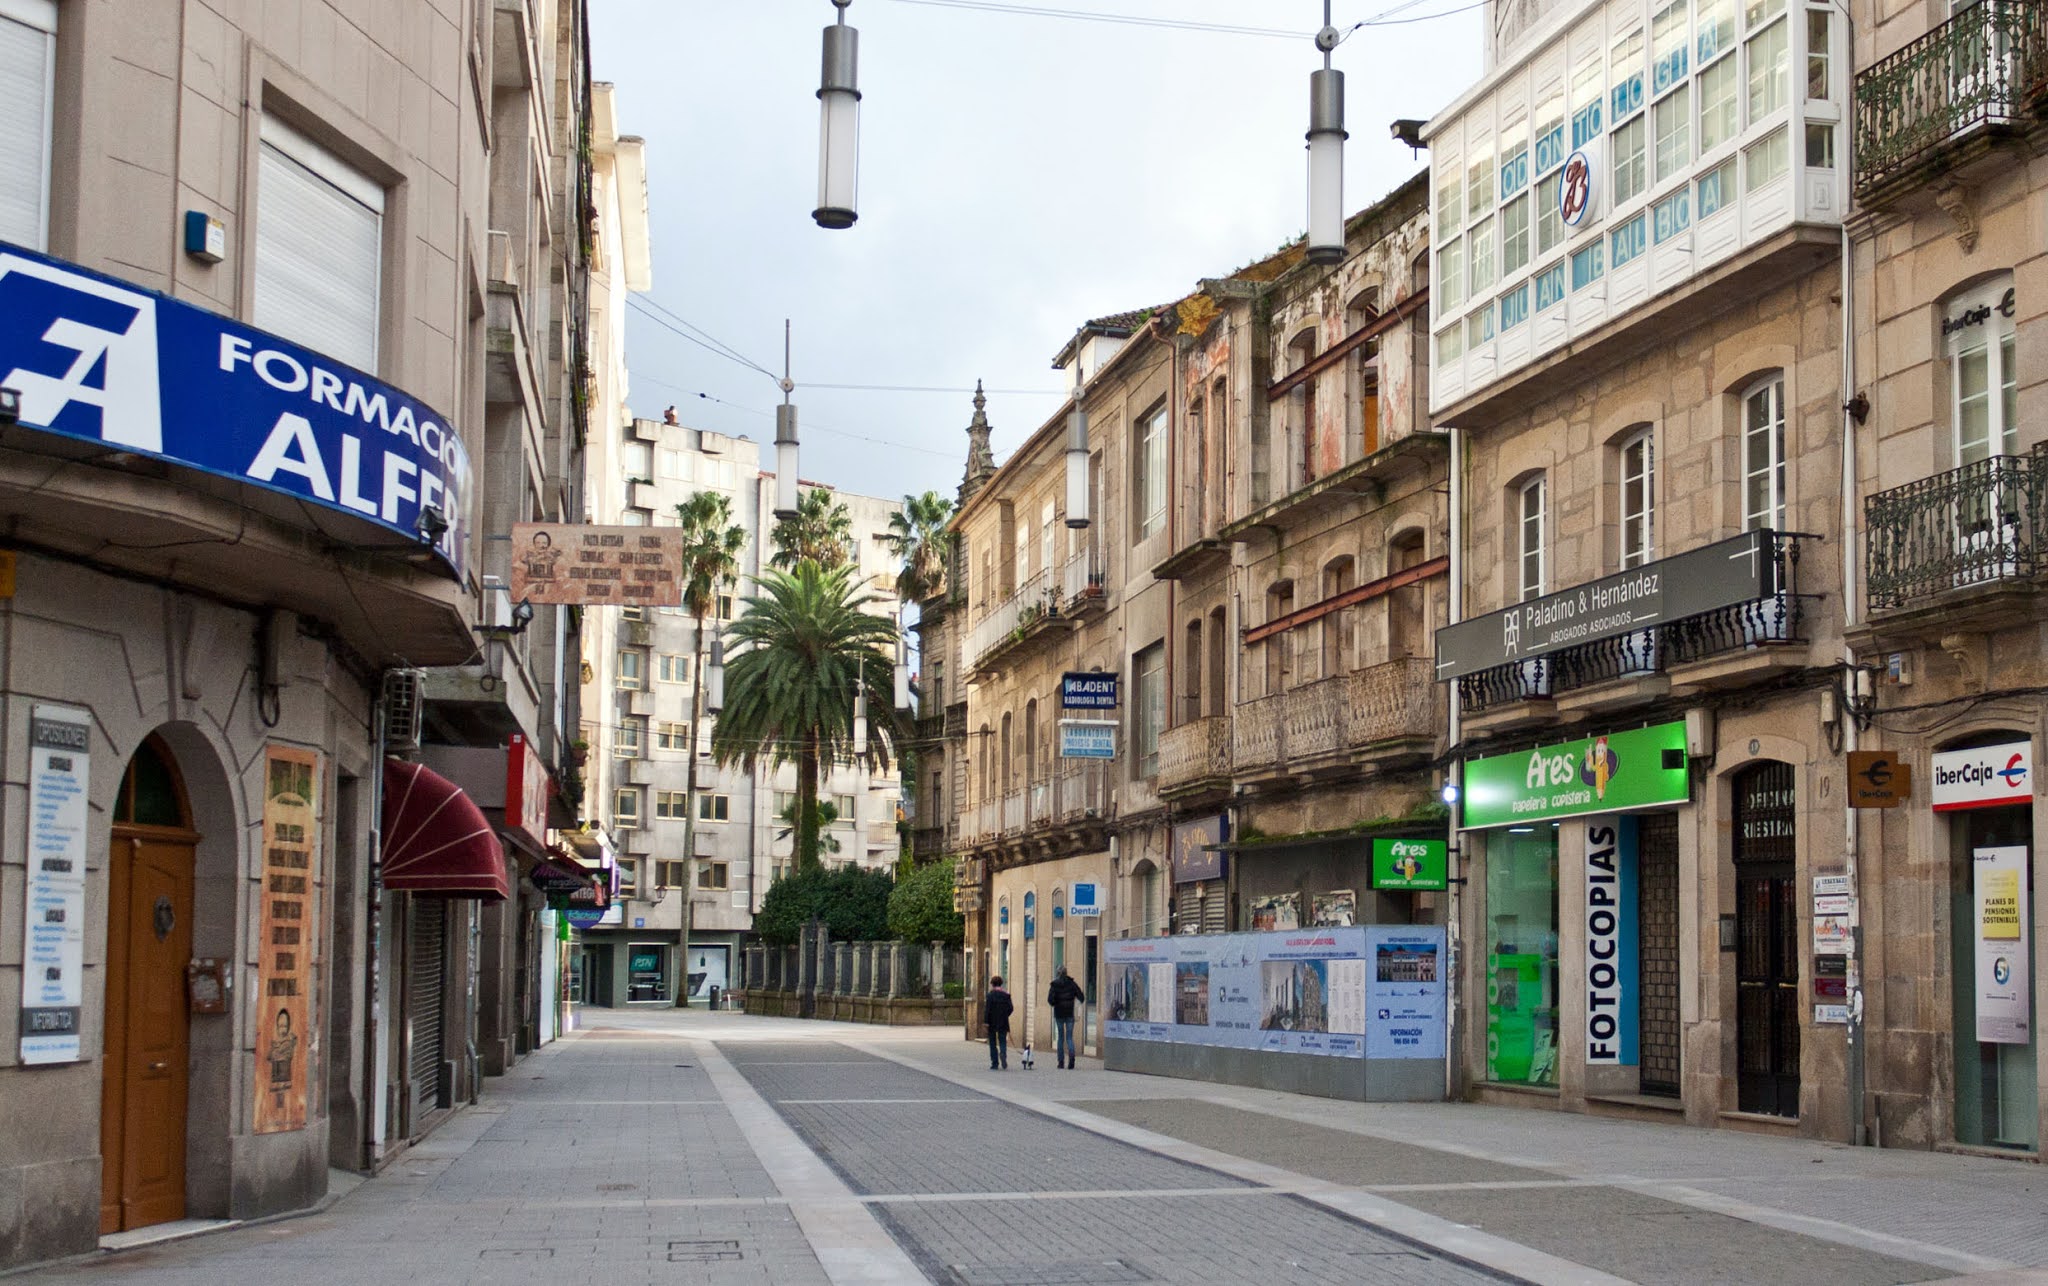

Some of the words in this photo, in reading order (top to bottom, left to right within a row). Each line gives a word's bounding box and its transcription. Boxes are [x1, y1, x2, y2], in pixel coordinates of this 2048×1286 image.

[1505, 271, 1564, 328] JUAN
[219, 332, 468, 472] FORMACIÓ
[1526, 598, 1575, 630] Paladino
[1578, 590, 1588, 612] &
[1592, 573, 1659, 612] Hernández
[1550, 624, 1588, 645] ABOGADOS
[1590, 610, 1632, 634] ASOCIADOS
[1069, 681, 1115, 692] ABADENT
[1526, 751, 1574, 789] Ares
[1936, 762, 1993, 786] iberCaja
[1390, 842, 1427, 856] Ares
[1071, 907, 1099, 915] Dental
[1985, 898, 2007, 906] PLANES
[2008, 897, 2015, 905] DE
[1982, 916, 2019, 925] SOSTENIBLES
[1984, 907, 2016, 916] PENSIONES
[1589, 826, 1616, 1060] FOTOCOPIAS
[634, 958, 653, 967] PSN
